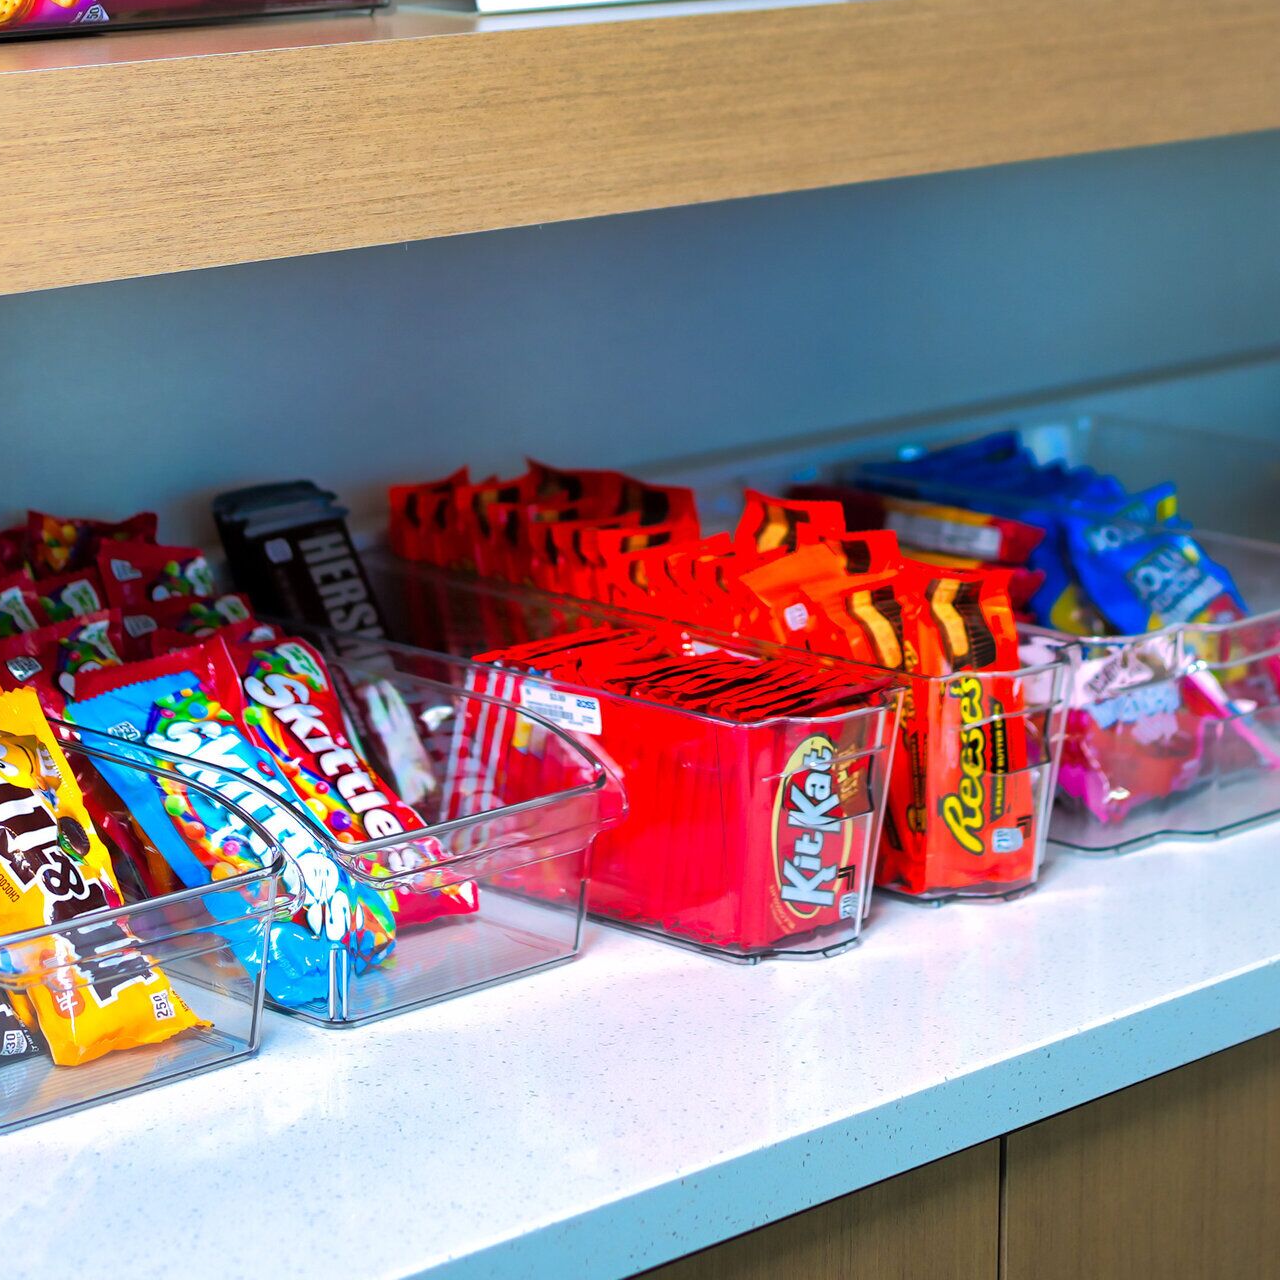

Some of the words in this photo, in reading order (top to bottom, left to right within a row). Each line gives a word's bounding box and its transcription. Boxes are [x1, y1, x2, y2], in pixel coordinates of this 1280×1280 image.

[244, 673, 422, 874] Skittles
[943, 676, 985, 856] Reese's
[152, 994, 169, 1019] 250
